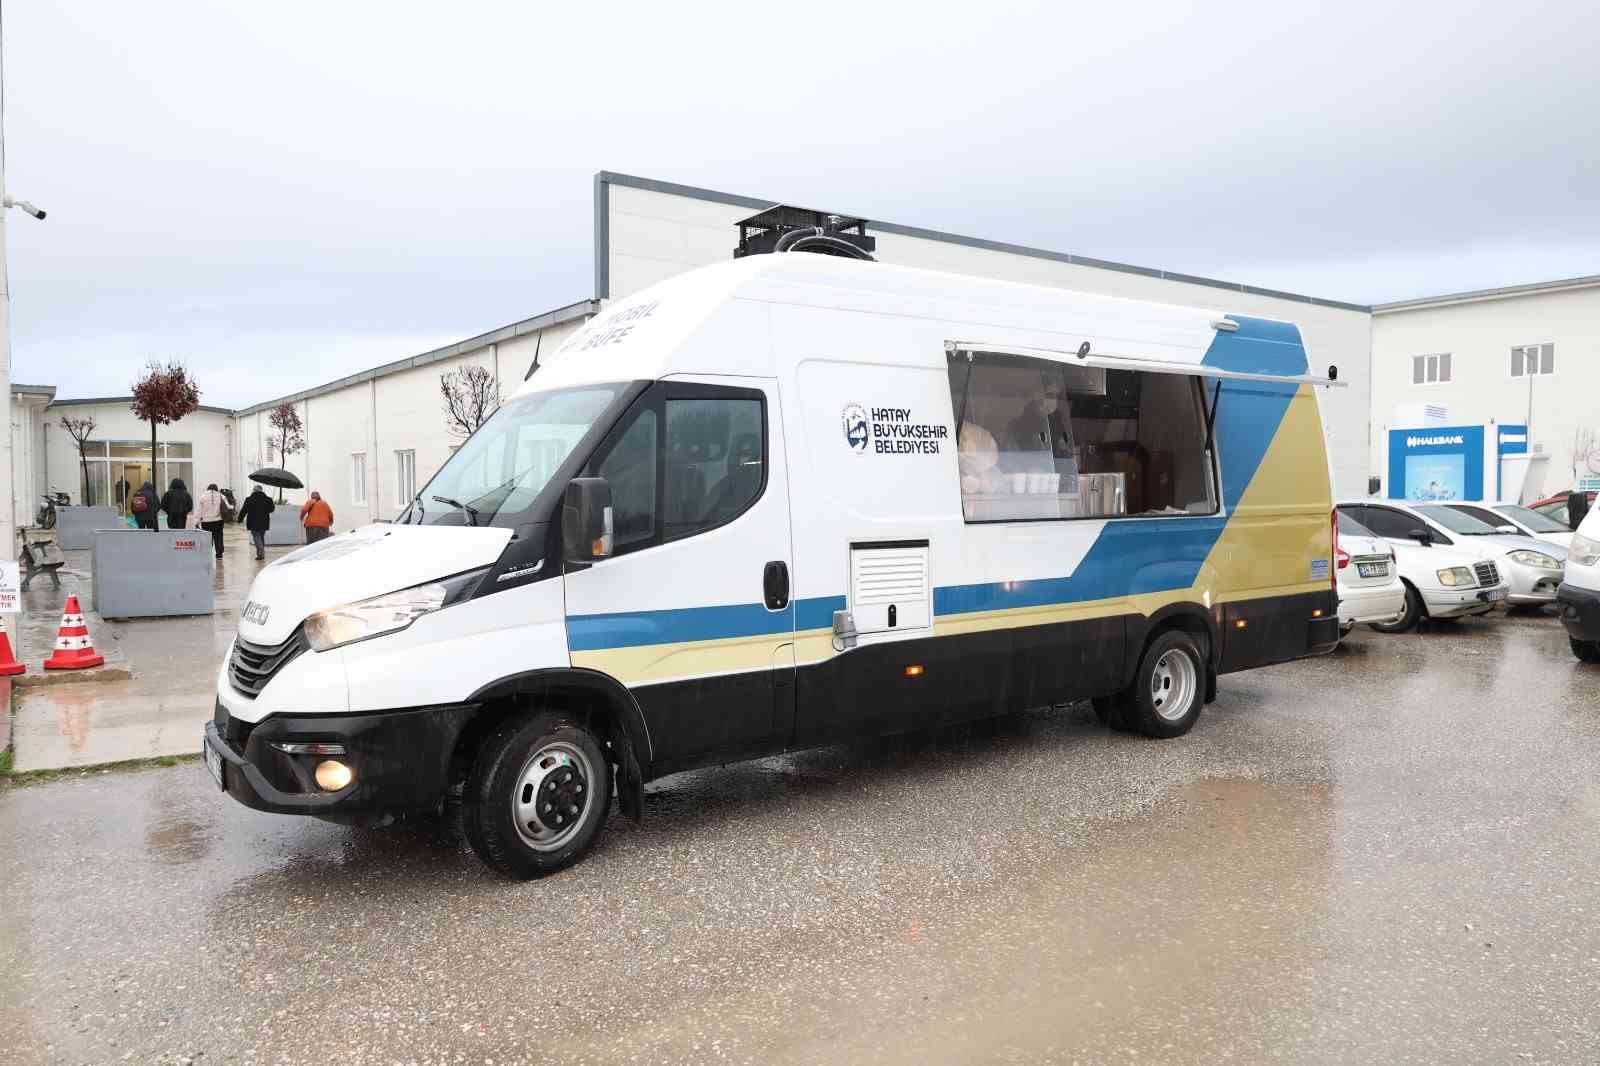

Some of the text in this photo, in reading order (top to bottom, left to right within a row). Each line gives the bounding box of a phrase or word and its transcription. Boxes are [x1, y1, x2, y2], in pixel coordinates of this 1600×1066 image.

[871, 407, 911, 422] HATAY
[873, 423, 948, 439] BÜYÜKŞEHİR
[875, 439, 939, 454] BELEDİYESİ
